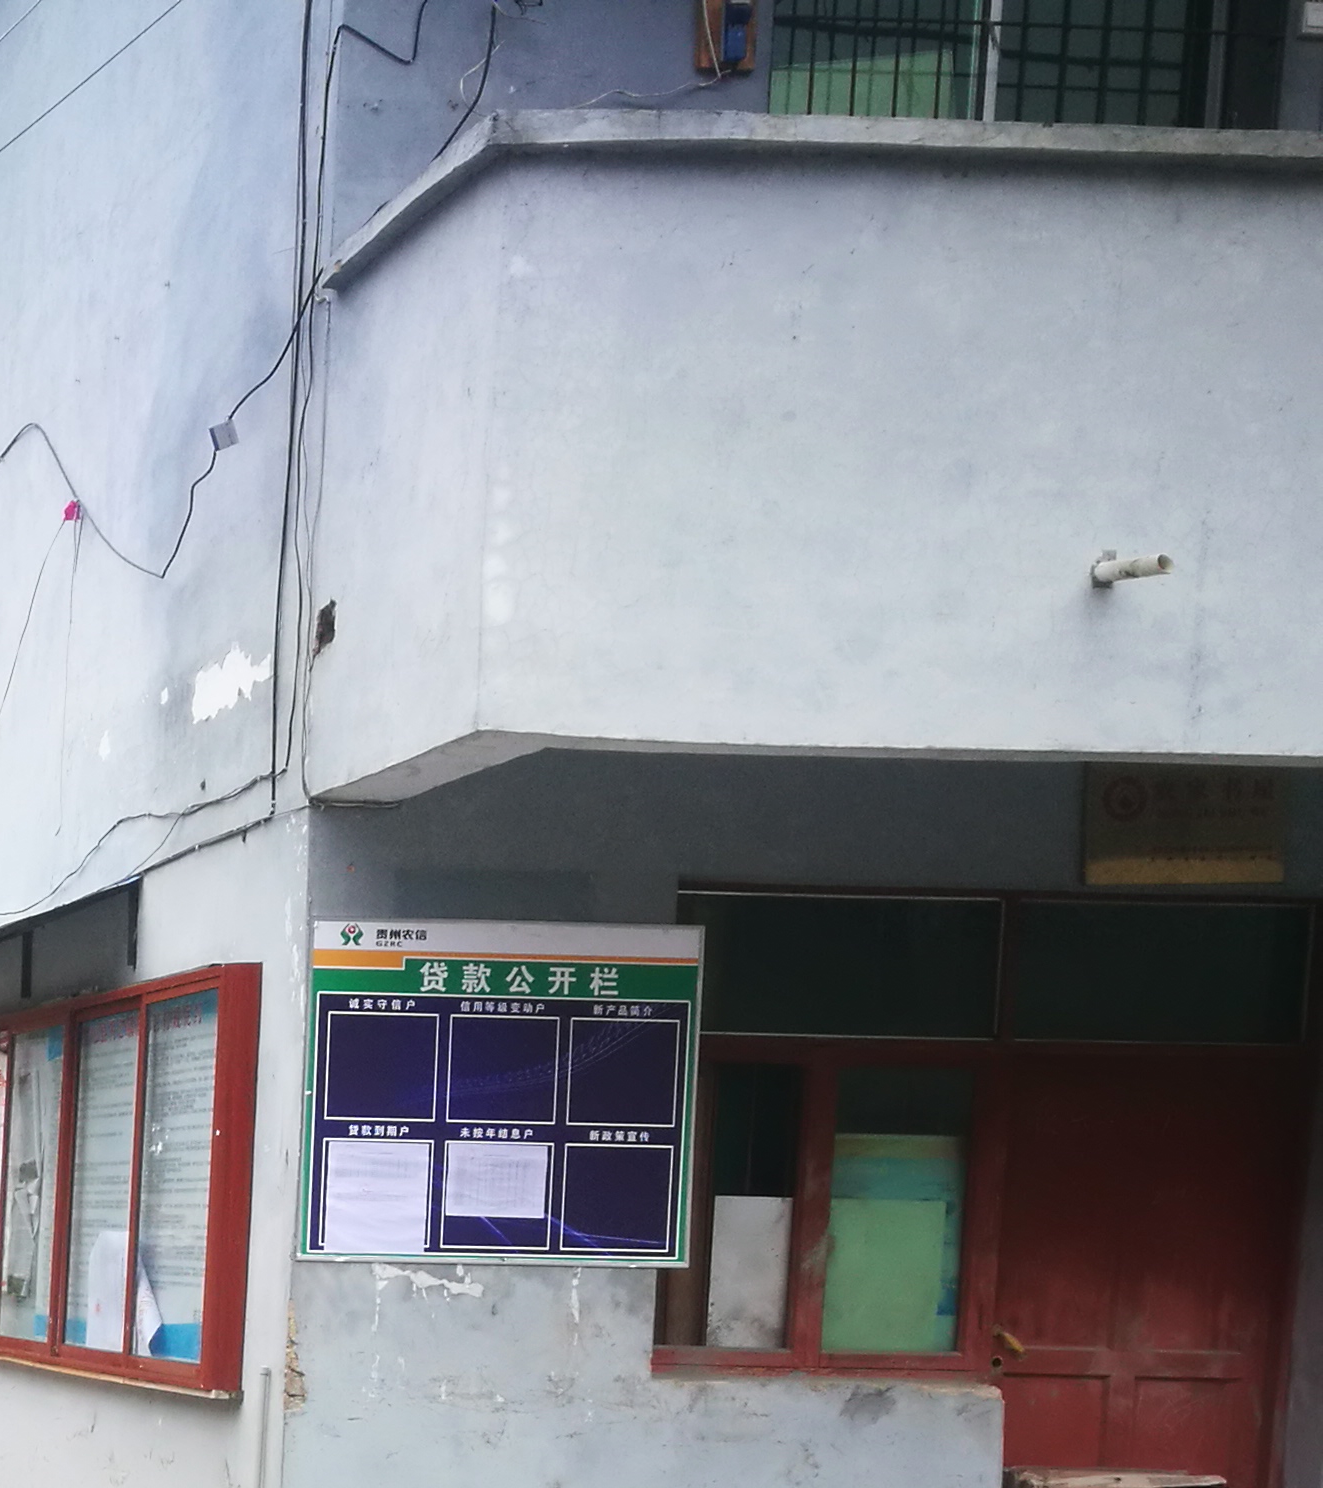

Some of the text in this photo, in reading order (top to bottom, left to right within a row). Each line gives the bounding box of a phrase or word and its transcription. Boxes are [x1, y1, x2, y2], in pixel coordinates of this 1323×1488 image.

[376, 929, 427, 940] 贵州农信
[419, 961, 620, 997] 贷款公开栏
[348, 998, 416, 1011] 诚实守信户
[460, 1001, 546, 1014] 信用等级变动户
[593, 1004, 653, 1017] 新产品简介
[348, 1124, 410, 1137] 贷款到期户
[460, 1126, 534, 1139] 未按年结息户
[589, 1130, 650, 1142] 新政策宣传
